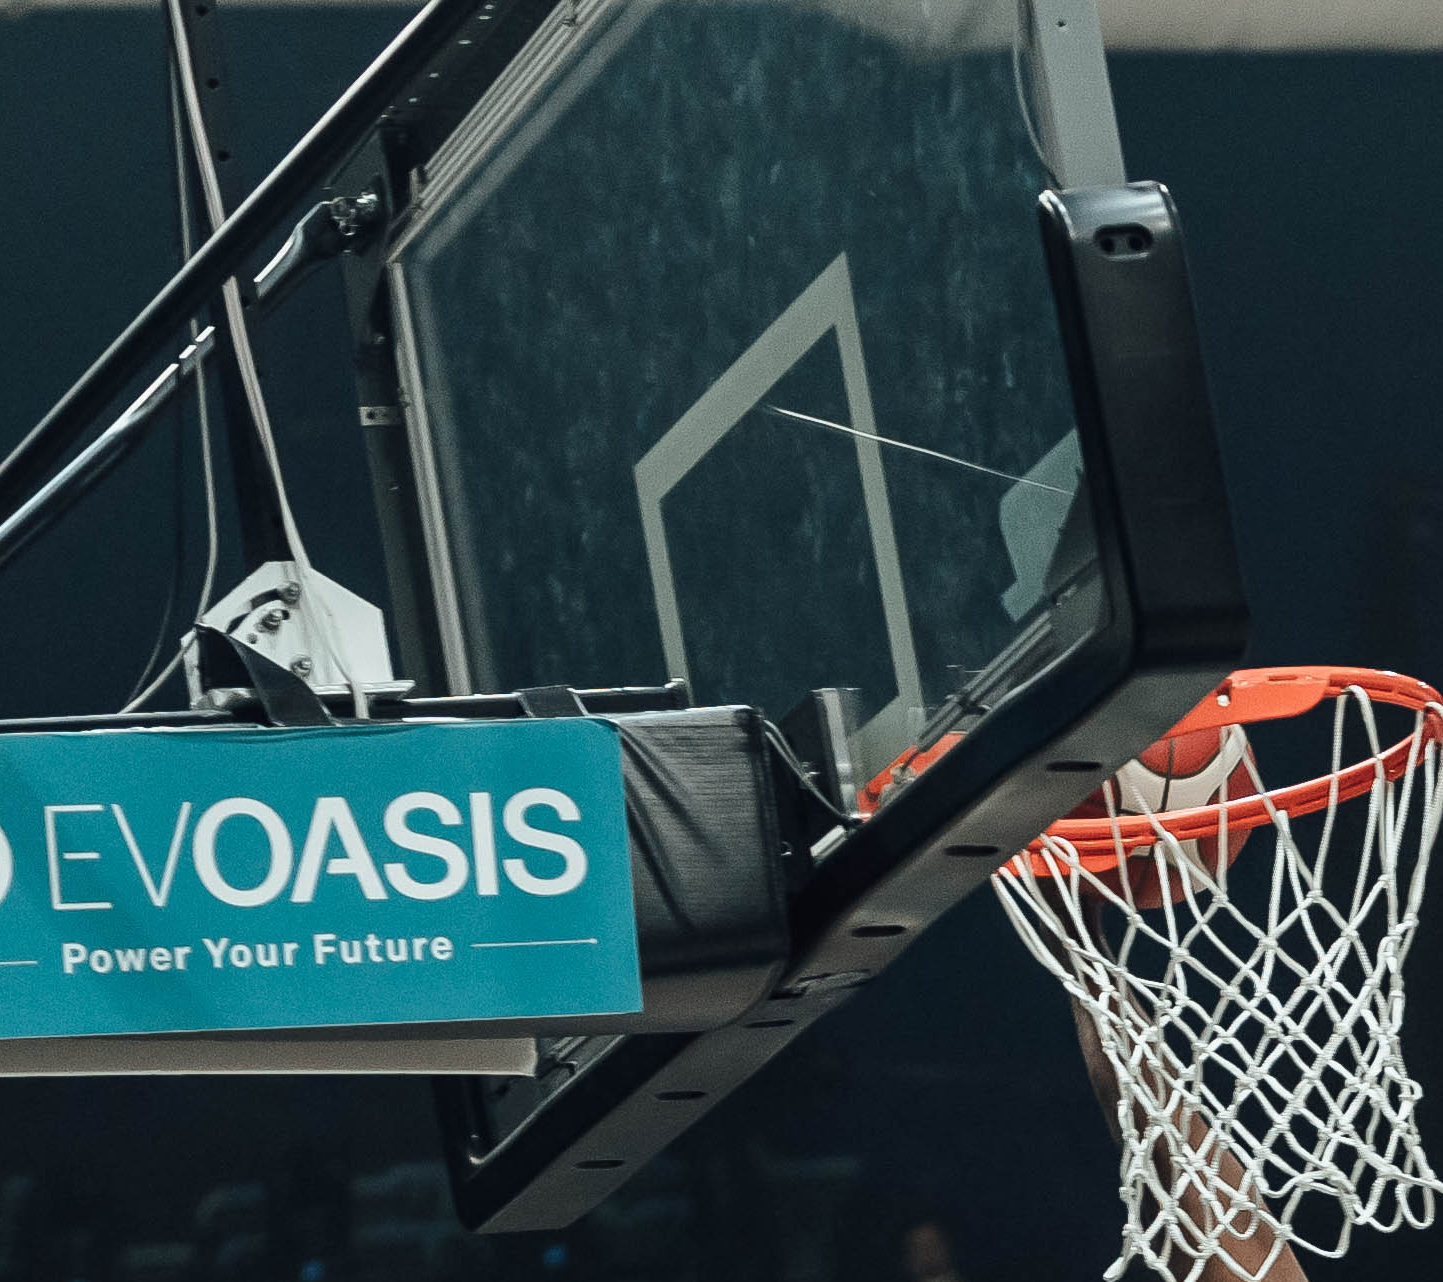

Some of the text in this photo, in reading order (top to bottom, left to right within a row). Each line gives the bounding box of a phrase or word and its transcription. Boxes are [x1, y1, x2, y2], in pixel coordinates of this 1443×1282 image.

[43, 785, 589, 913] EVOASIS
[61, 931, 454, 976] Power Your Future
